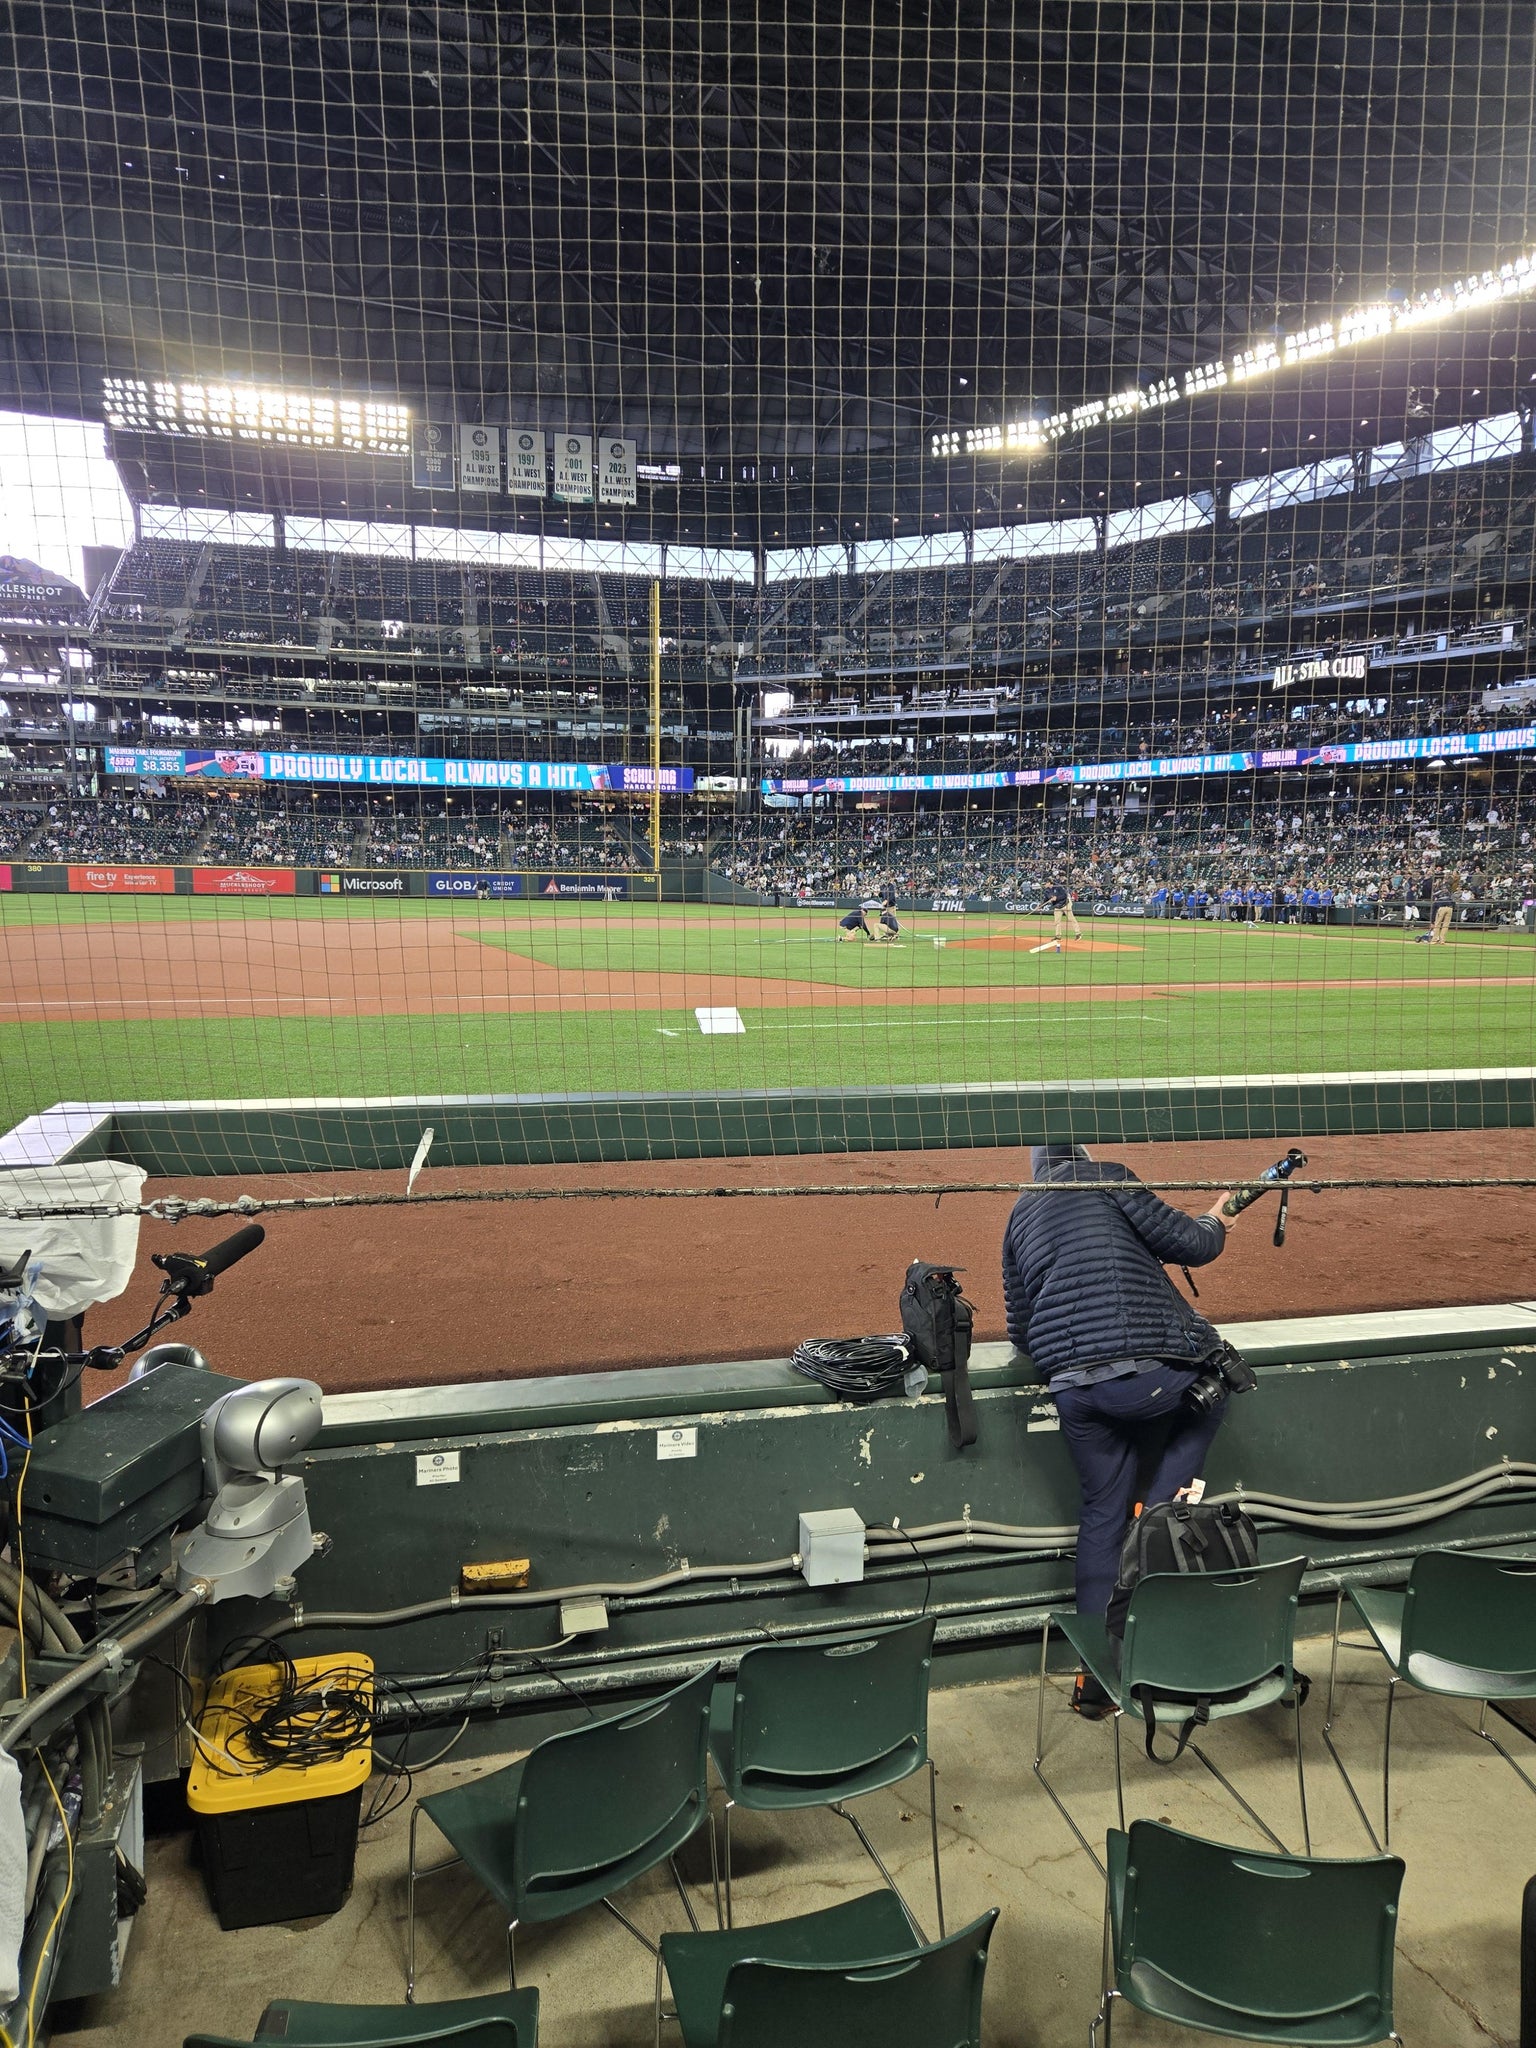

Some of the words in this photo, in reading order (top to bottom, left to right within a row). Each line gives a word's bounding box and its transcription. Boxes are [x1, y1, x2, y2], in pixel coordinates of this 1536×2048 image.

[472, 450, 490, 461] 1995
[518, 454, 535, 465] 1997
[466, 463, 477, 473] A.L.
[478, 464, 495, 474] WEST
[565, 458, 583, 470] 2001
[608, 462, 627, 474] 2025
[513, 467, 523, 477] A.L.
[524, 469, 541, 478] WEST
[559, 471, 569, 481] A.L.
[571, 473, 587, 483] WEST
[463, 476, 499, 487] CHAMPIONS
[509, 480, 545, 491] CHAMPIONS
[604, 475, 615, 484] A.L.
[616, 476, 631, 486] WEST
[556, 483, 592, 495] CHAMPIONS
[601, 487, 635, 499] CHAMPIONS
[1332, 655, 1366, 679] CLUB
[1354, 737, 1418, 761] PROUDLY
[1422, 736, 1474, 757] LOCAL.
[1479, 728, 1535, 751] ALWAYS
[143, 760, 180, 771] $8,355
[1080, 765, 1121, 780] PROUDLY
[1124, 762, 1157, 777] LOCAL.
[1159, 758, 1201, 776] ALWAYS
[1204, 757, 1210, 771] A
[270, 755, 363, 780] PROUDLY
[369, 759, 438, 783] LOCAL.
[445, 762, 522, 785] ALWAYS
[529, 764, 541, 786] A
[547, 766, 582, 788] HIT.
[86, 871, 104, 881] fire
[106, 872, 117, 881] tv
[343, 877, 403, 890] Microsoft
[560, 884, 596, 893] Benjamin
[932, 901, 966, 912] STIHL
[1005, 902, 1028, 911] Great
[1107, 906, 1145, 914] LEXUS
